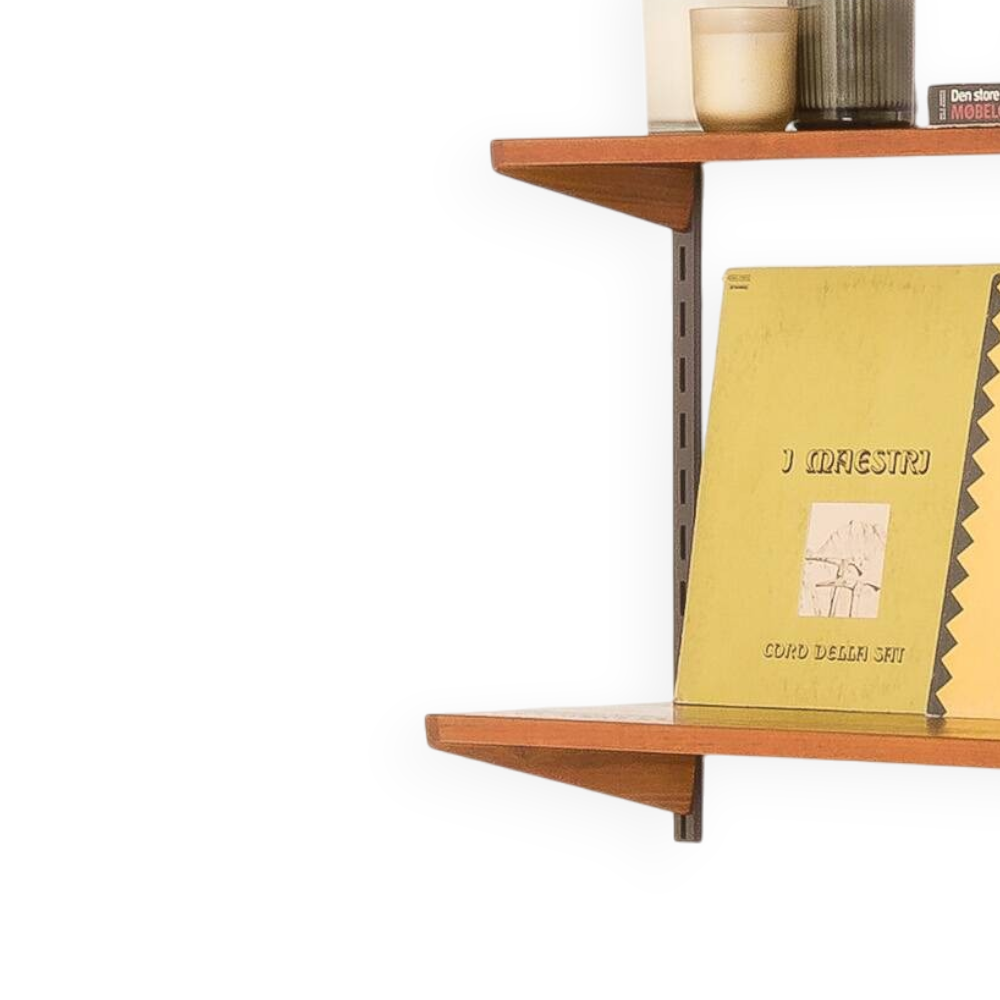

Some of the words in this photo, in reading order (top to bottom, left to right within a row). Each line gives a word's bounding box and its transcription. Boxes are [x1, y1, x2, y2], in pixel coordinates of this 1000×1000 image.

[950, 88, 972, 102] Den
[973, 87, 1000, 101] store
[805, 449, 931, 475] MAESTRI
[764, 643, 810, 660] CORO
[814, 644, 869, 662] DELLA
[873, 646, 906, 664] SAT
